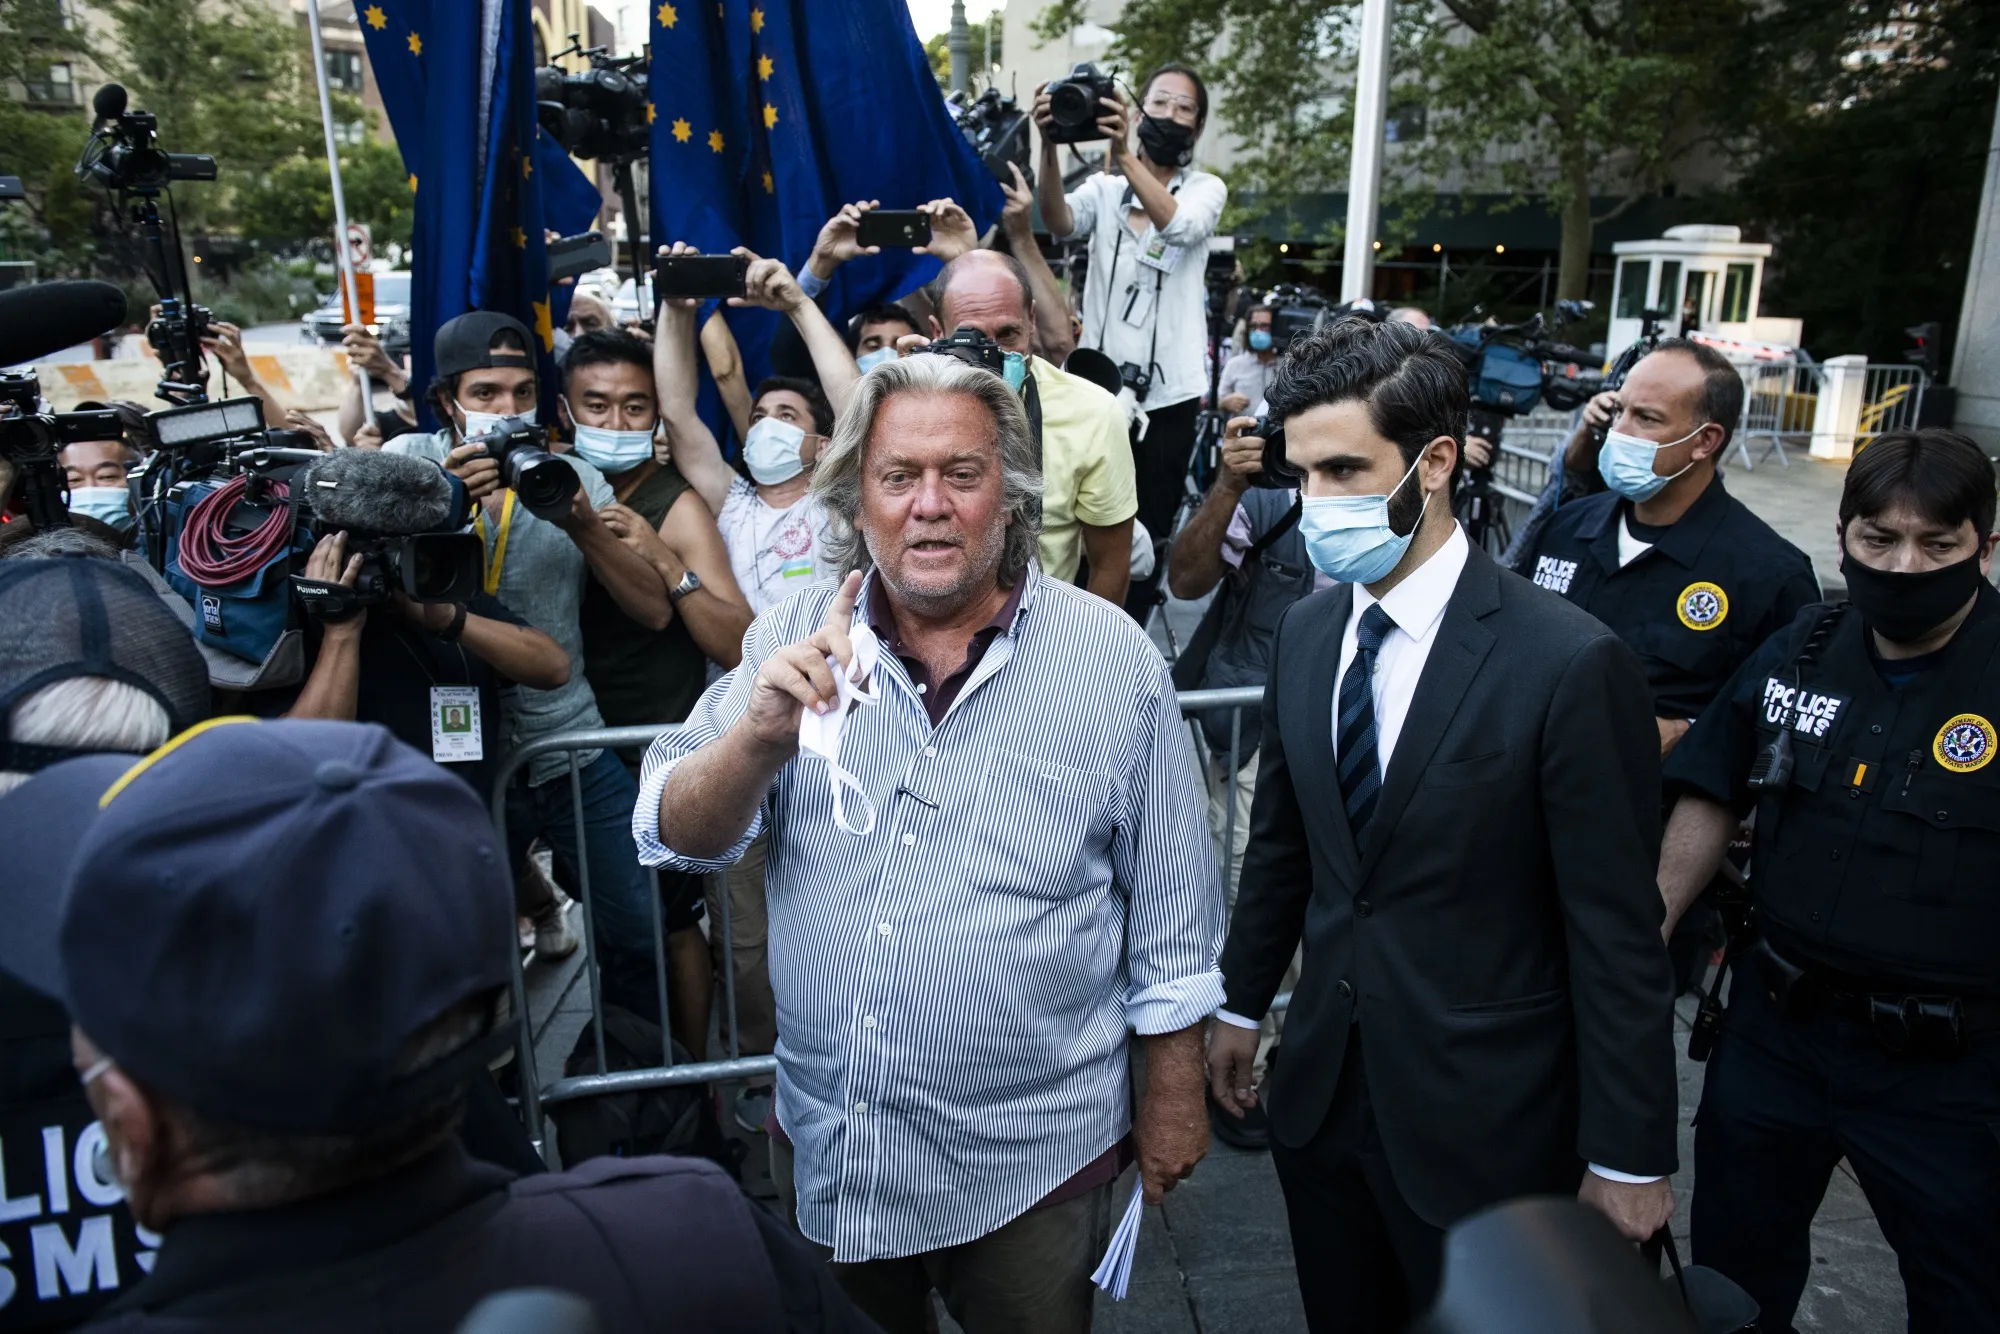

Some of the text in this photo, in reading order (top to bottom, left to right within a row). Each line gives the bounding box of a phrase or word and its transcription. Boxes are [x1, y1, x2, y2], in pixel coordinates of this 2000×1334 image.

[511, 431, 529, 439] Canon
[1536, 555, 1577, 580] POLICE
[296, 585, 329, 595] FUJINON
[1532, 571, 1570, 594] USMS
[432, 700, 440, 744] PRESS
[473, 700, 481, 743] PRESS
[1940, 717, 1976, 737] DEPARTMENT
[1982, 726, 1994, 748] JUSTICE
[1937, 741, 1990, 769] UNITED STATES MARSHAL
